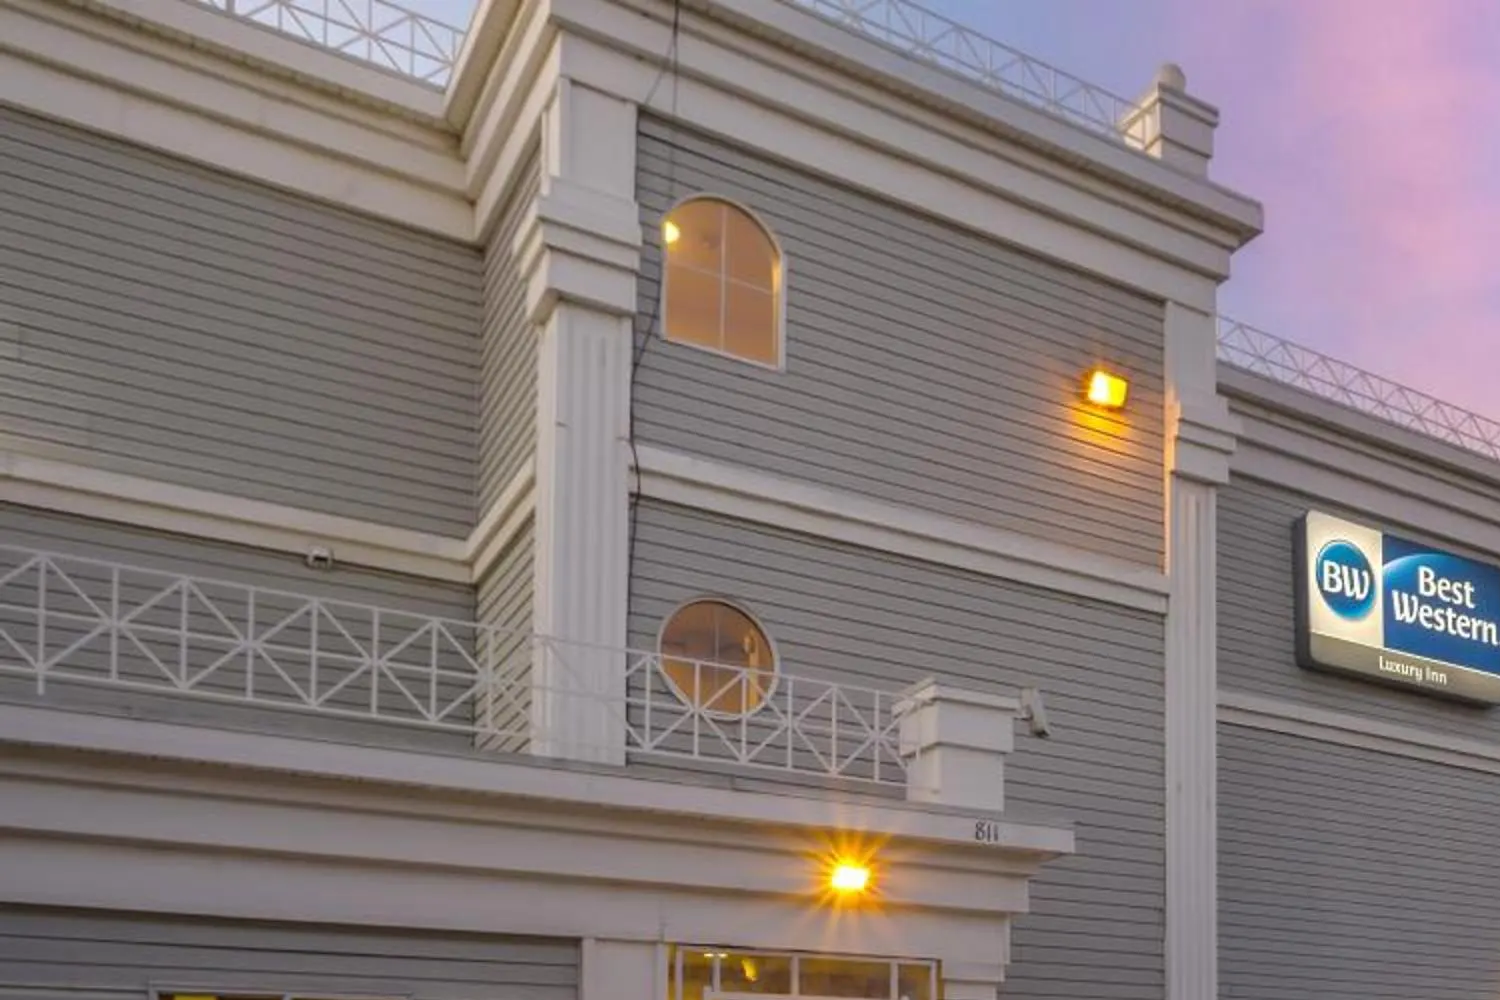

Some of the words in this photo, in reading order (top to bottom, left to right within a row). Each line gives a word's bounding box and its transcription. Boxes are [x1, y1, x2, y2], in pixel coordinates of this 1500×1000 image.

[1323, 560, 1370, 600] BW
[1418, 565, 1475, 609] Best
[1379, 655, 1424, 685] Luxury
[1425, 665, 1447, 685] Inn
[975, 820, 999, 842] 811
